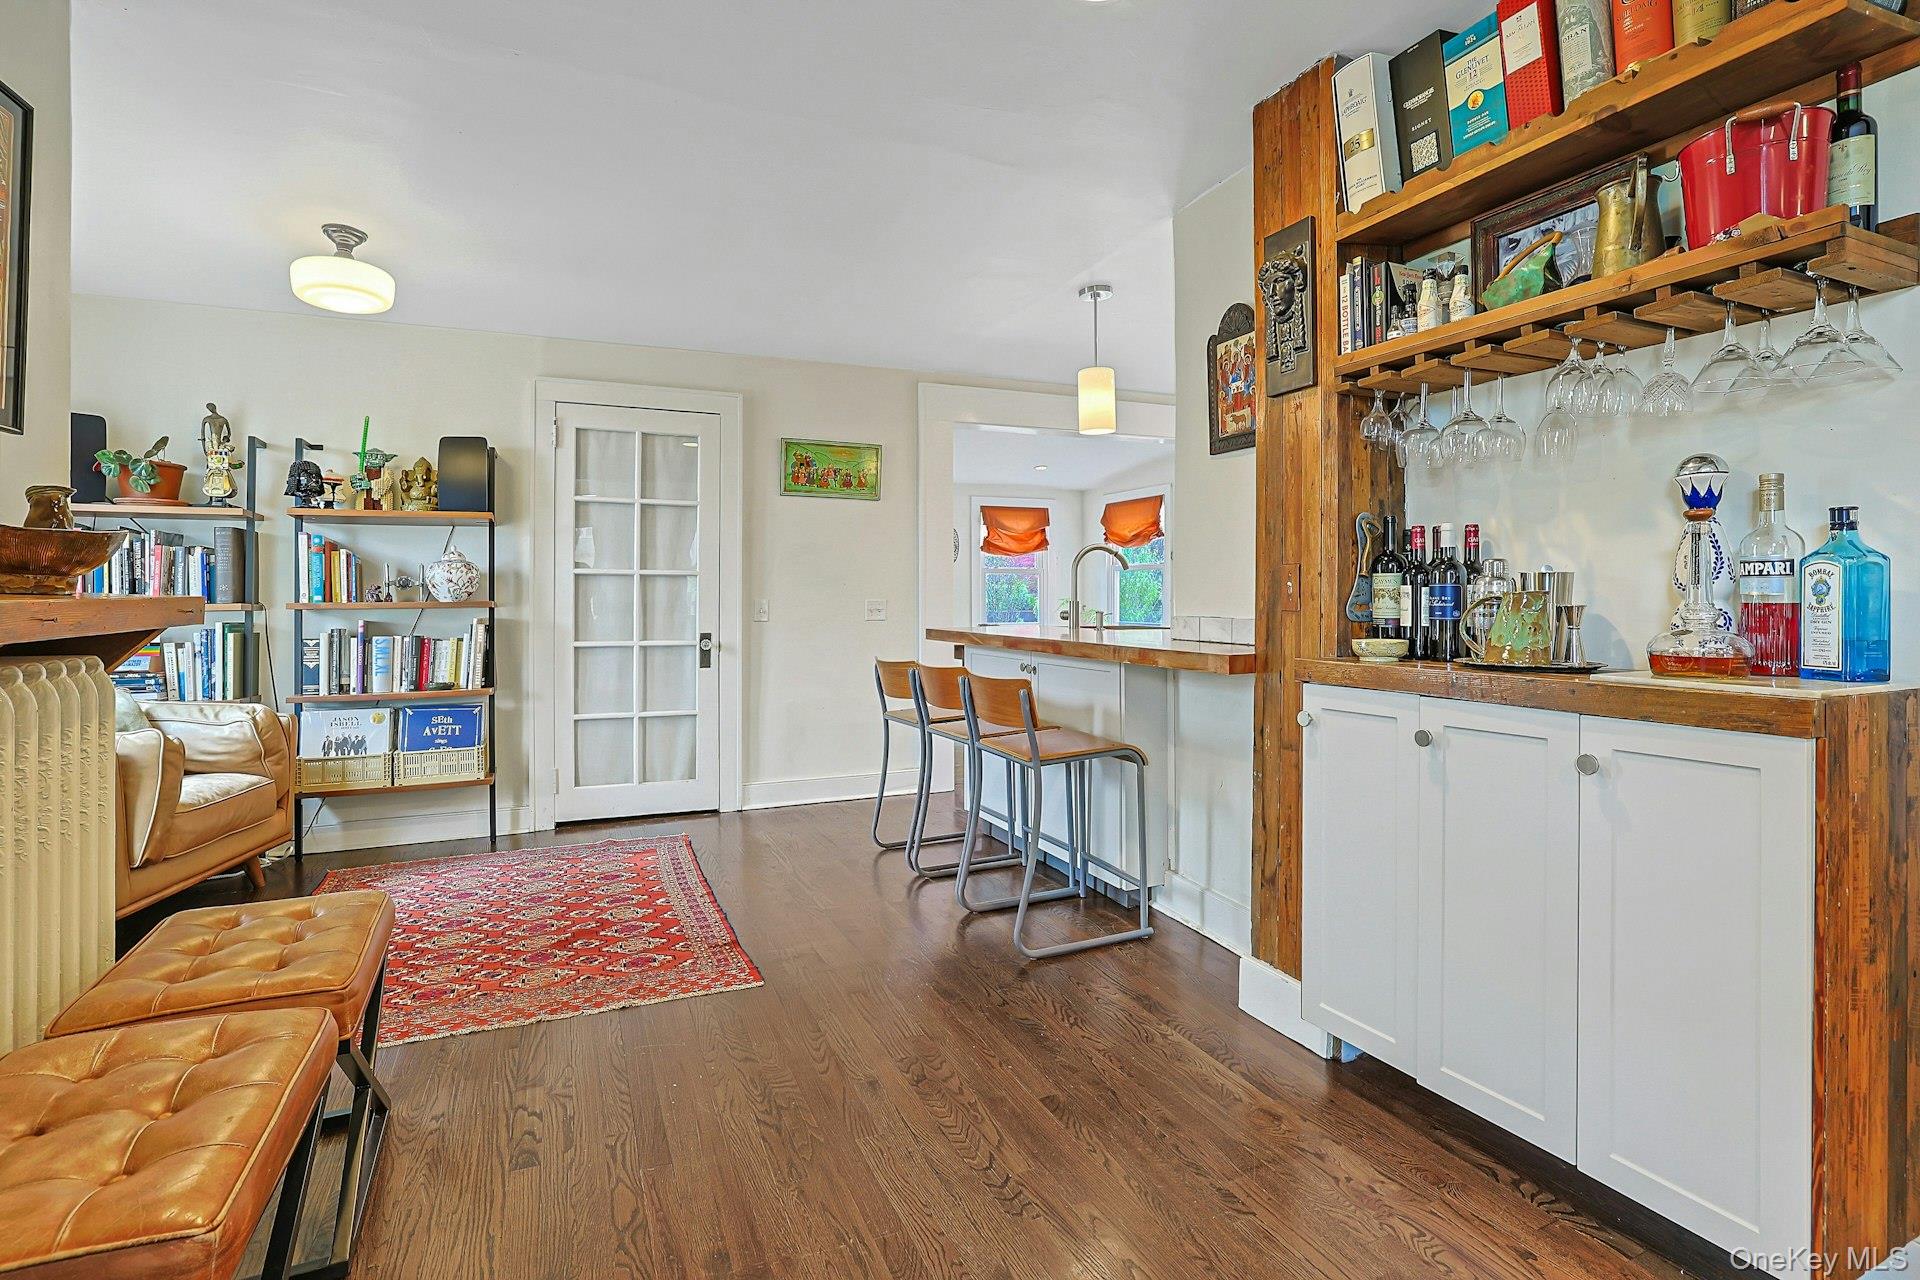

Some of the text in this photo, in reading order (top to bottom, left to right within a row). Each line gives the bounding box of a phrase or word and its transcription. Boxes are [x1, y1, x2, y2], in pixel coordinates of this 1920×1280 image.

[1562, 27, 1588, 44] OBAN
[1455, 55, 1490, 80] GLENLIVET
[1468, 70, 1477, 81] 12
[1411, 117, 1432, 131] SIGNET
[1349, 138, 1361, 153] 25
[1341, 295, 1348, 303] 12
[1342, 305, 1350, 339] BOTTLE
[1808, 568, 1835, 579] BOMBAY
[1806, 602, 1836, 613] SAPPHIRE
